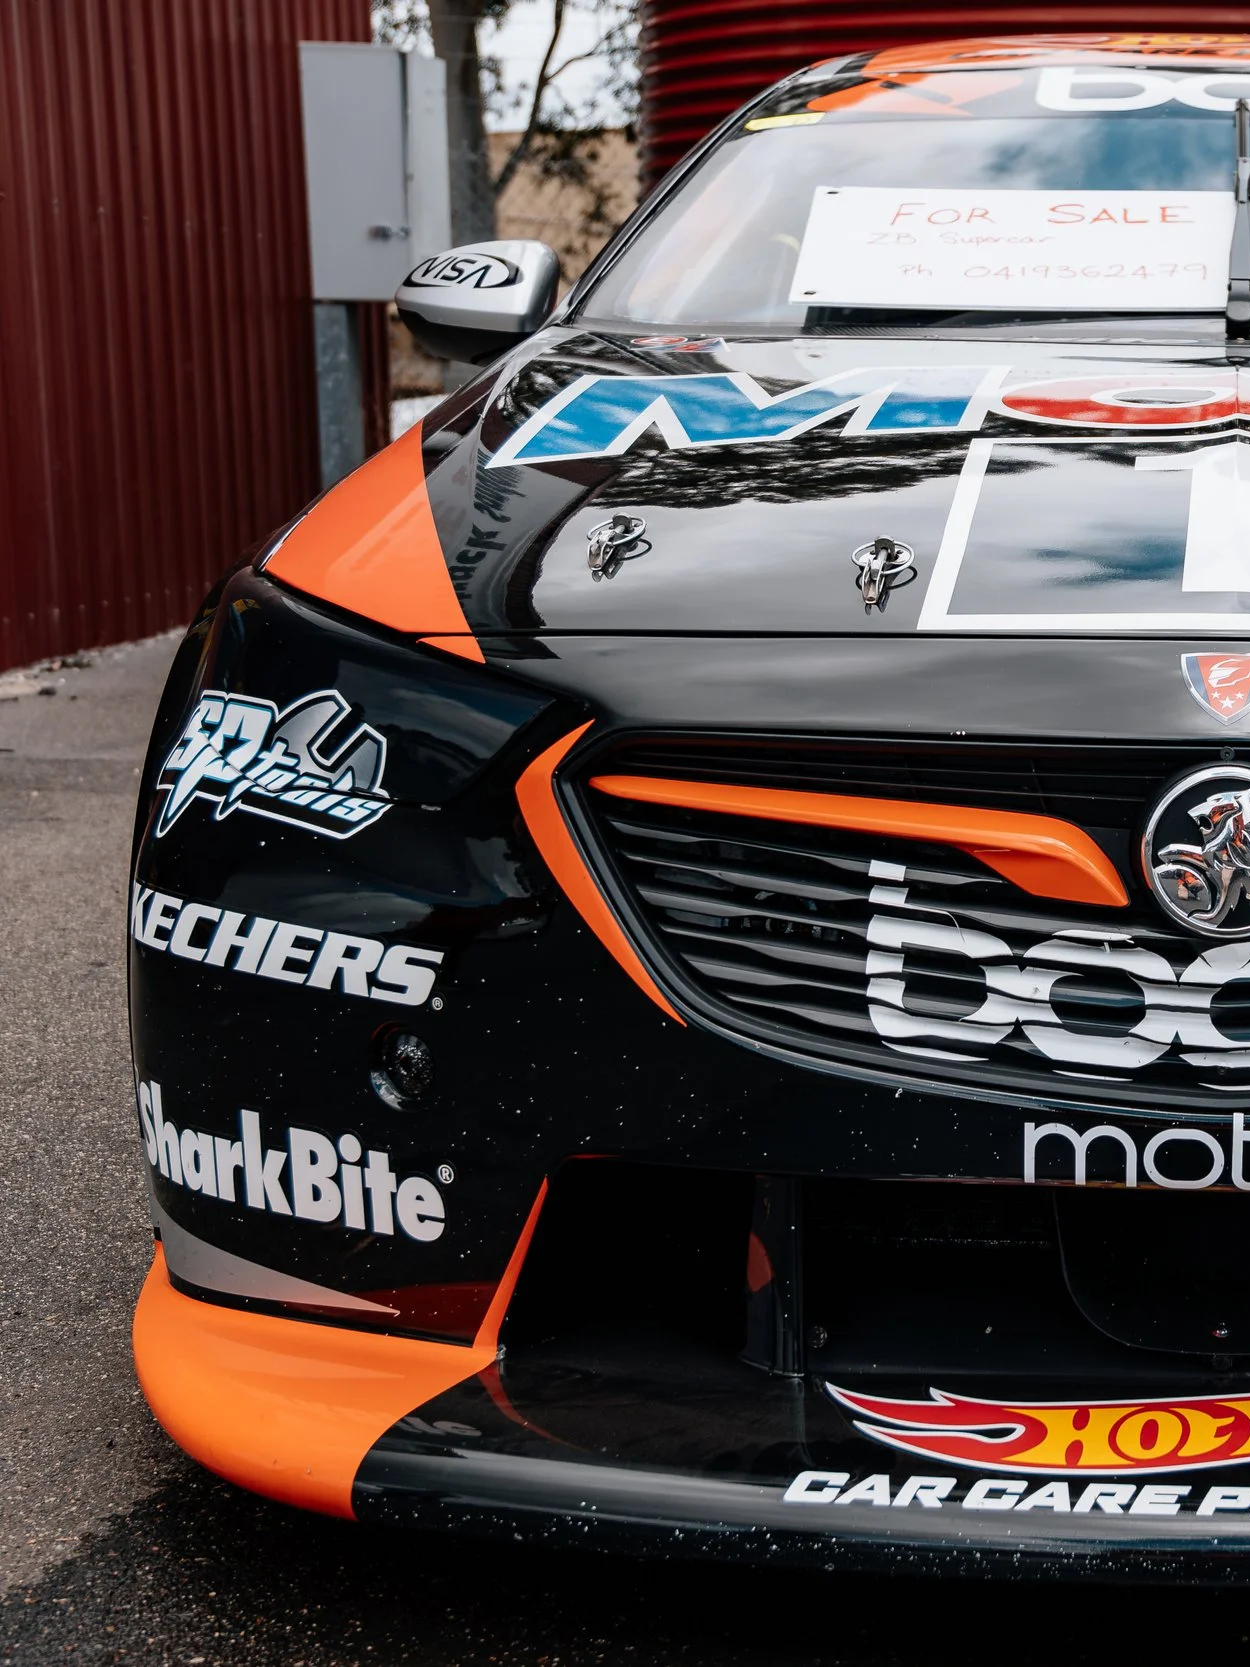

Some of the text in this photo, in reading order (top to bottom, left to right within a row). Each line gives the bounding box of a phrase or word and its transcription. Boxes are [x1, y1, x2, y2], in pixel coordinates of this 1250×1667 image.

[890, 202, 1196, 226] FOR SALE
[866, 231, 919, 247] ZB
[420, 255, 494, 289] VISA
[963, 262, 1209, 281] 0419362479
[131, 880, 445, 1006] KECHERS
[140, 1080, 446, 1242] SharkBite
[1001, 1400, 1236, 1466] HOT
[783, 1471, 958, 1508] CAR
[962, 1479, 1192, 1515] CARE
